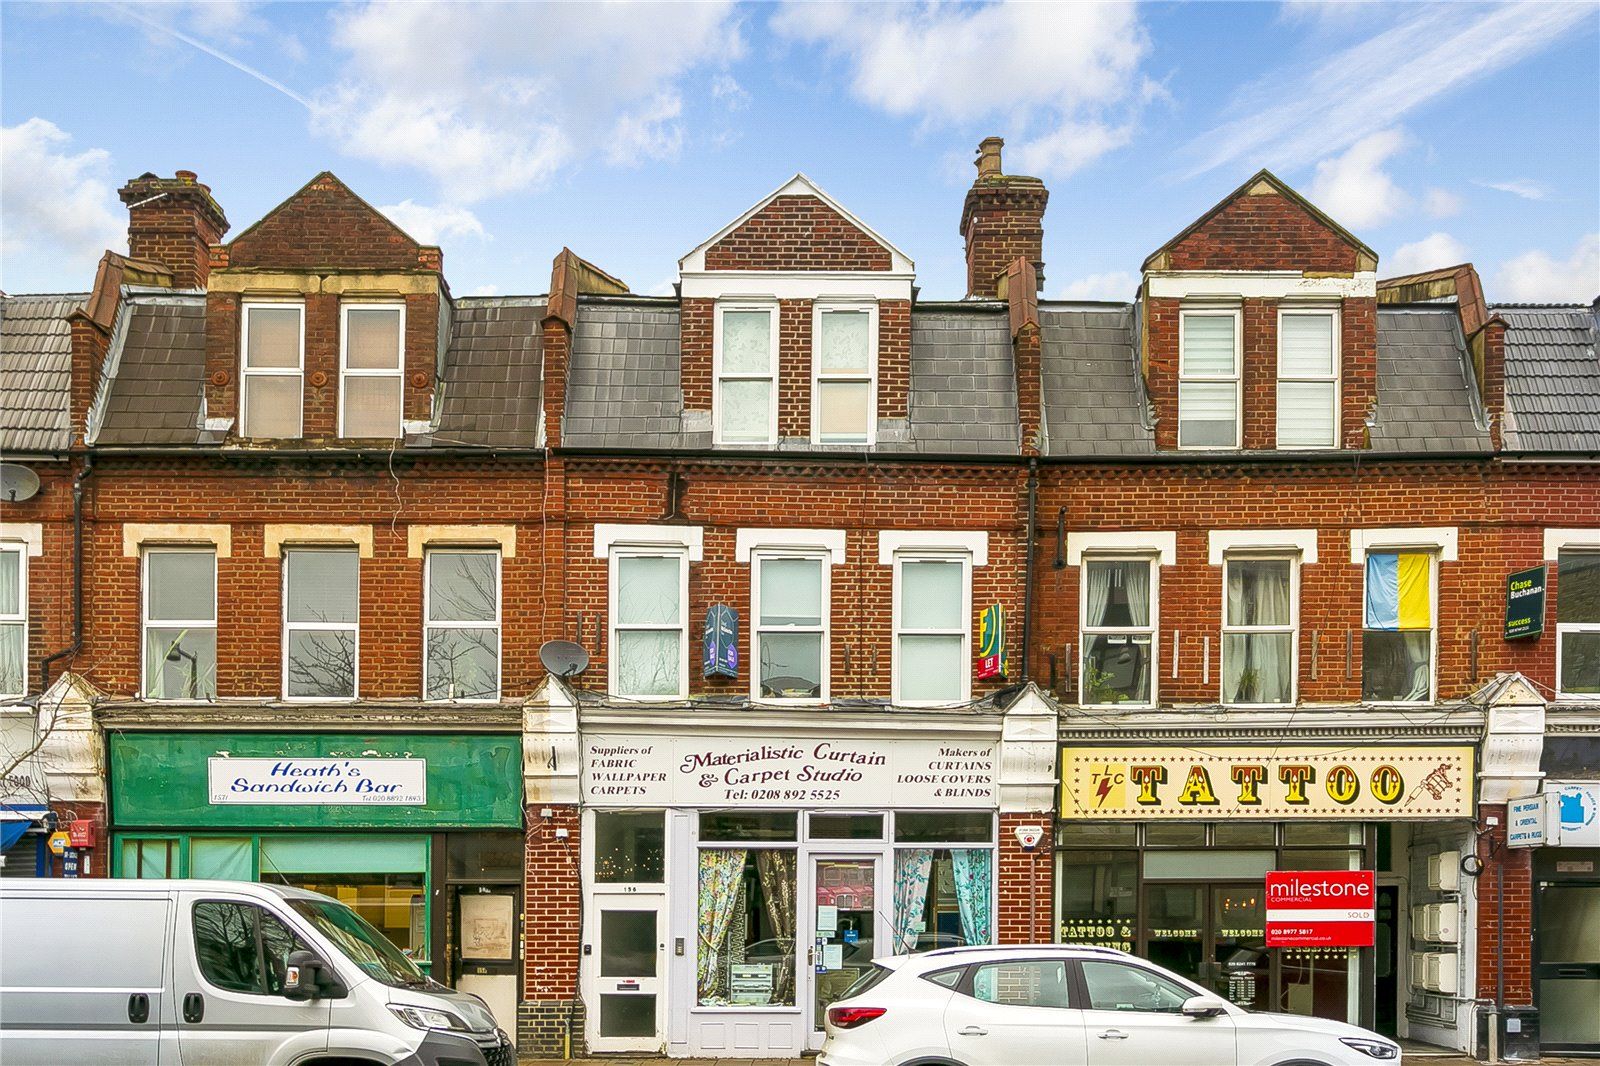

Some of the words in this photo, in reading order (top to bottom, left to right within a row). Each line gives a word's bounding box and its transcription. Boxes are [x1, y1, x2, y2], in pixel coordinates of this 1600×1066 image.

[1511, 580, 1532, 590] Chase
[1510, 586, 1542, 599] Buchanan
[1508, 618, 1531, 627] success
[985, 658, 994, 668] LET
[590, 746, 638, 756] Suppliers
[641, 746, 653, 754] of
[938, 748, 978, 757] Makers
[980, 748, 992, 756] of
[680, 745, 804, 773] Materialistic
[814, 742, 886, 765] Curtain
[271, 762, 361, 776] Heath's
[591, 760, 637, 768] FABRIC
[929, 762, 992, 770] CURTAINS
[592, 773, 667, 781] WALLPAPER
[699, 773, 718, 787] &
[724, 768, 790, 785] Carpet
[797, 765, 862, 782] Studio
[897, 775, 939, 783] LOOSE
[941, 775, 992, 783] COVERS
[231, 778, 348, 793] Sandwich
[355, 778, 403, 793] Bar
[591, 786, 647, 794] CARPETS
[1092, 765, 1124, 784] TLC
[1130, 765, 1405, 806] TATTOO
[724, 789, 748, 800] Tel:
[751, 789, 780, 800] 0208
[784, 789, 805, 800] 892
[810, 789, 840, 800] 5525
[934, 788, 942, 797] &
[945, 788, 991, 797] BLINDS
[1523, 803, 1539, 812] PERSIAN
[1520, 818, 1537, 826] ORIENTAL
[1270, 879, 1369, 896] milestone
[1061, 926, 1114, 937] TATTOO
[1121, 926, 1131, 937] &
